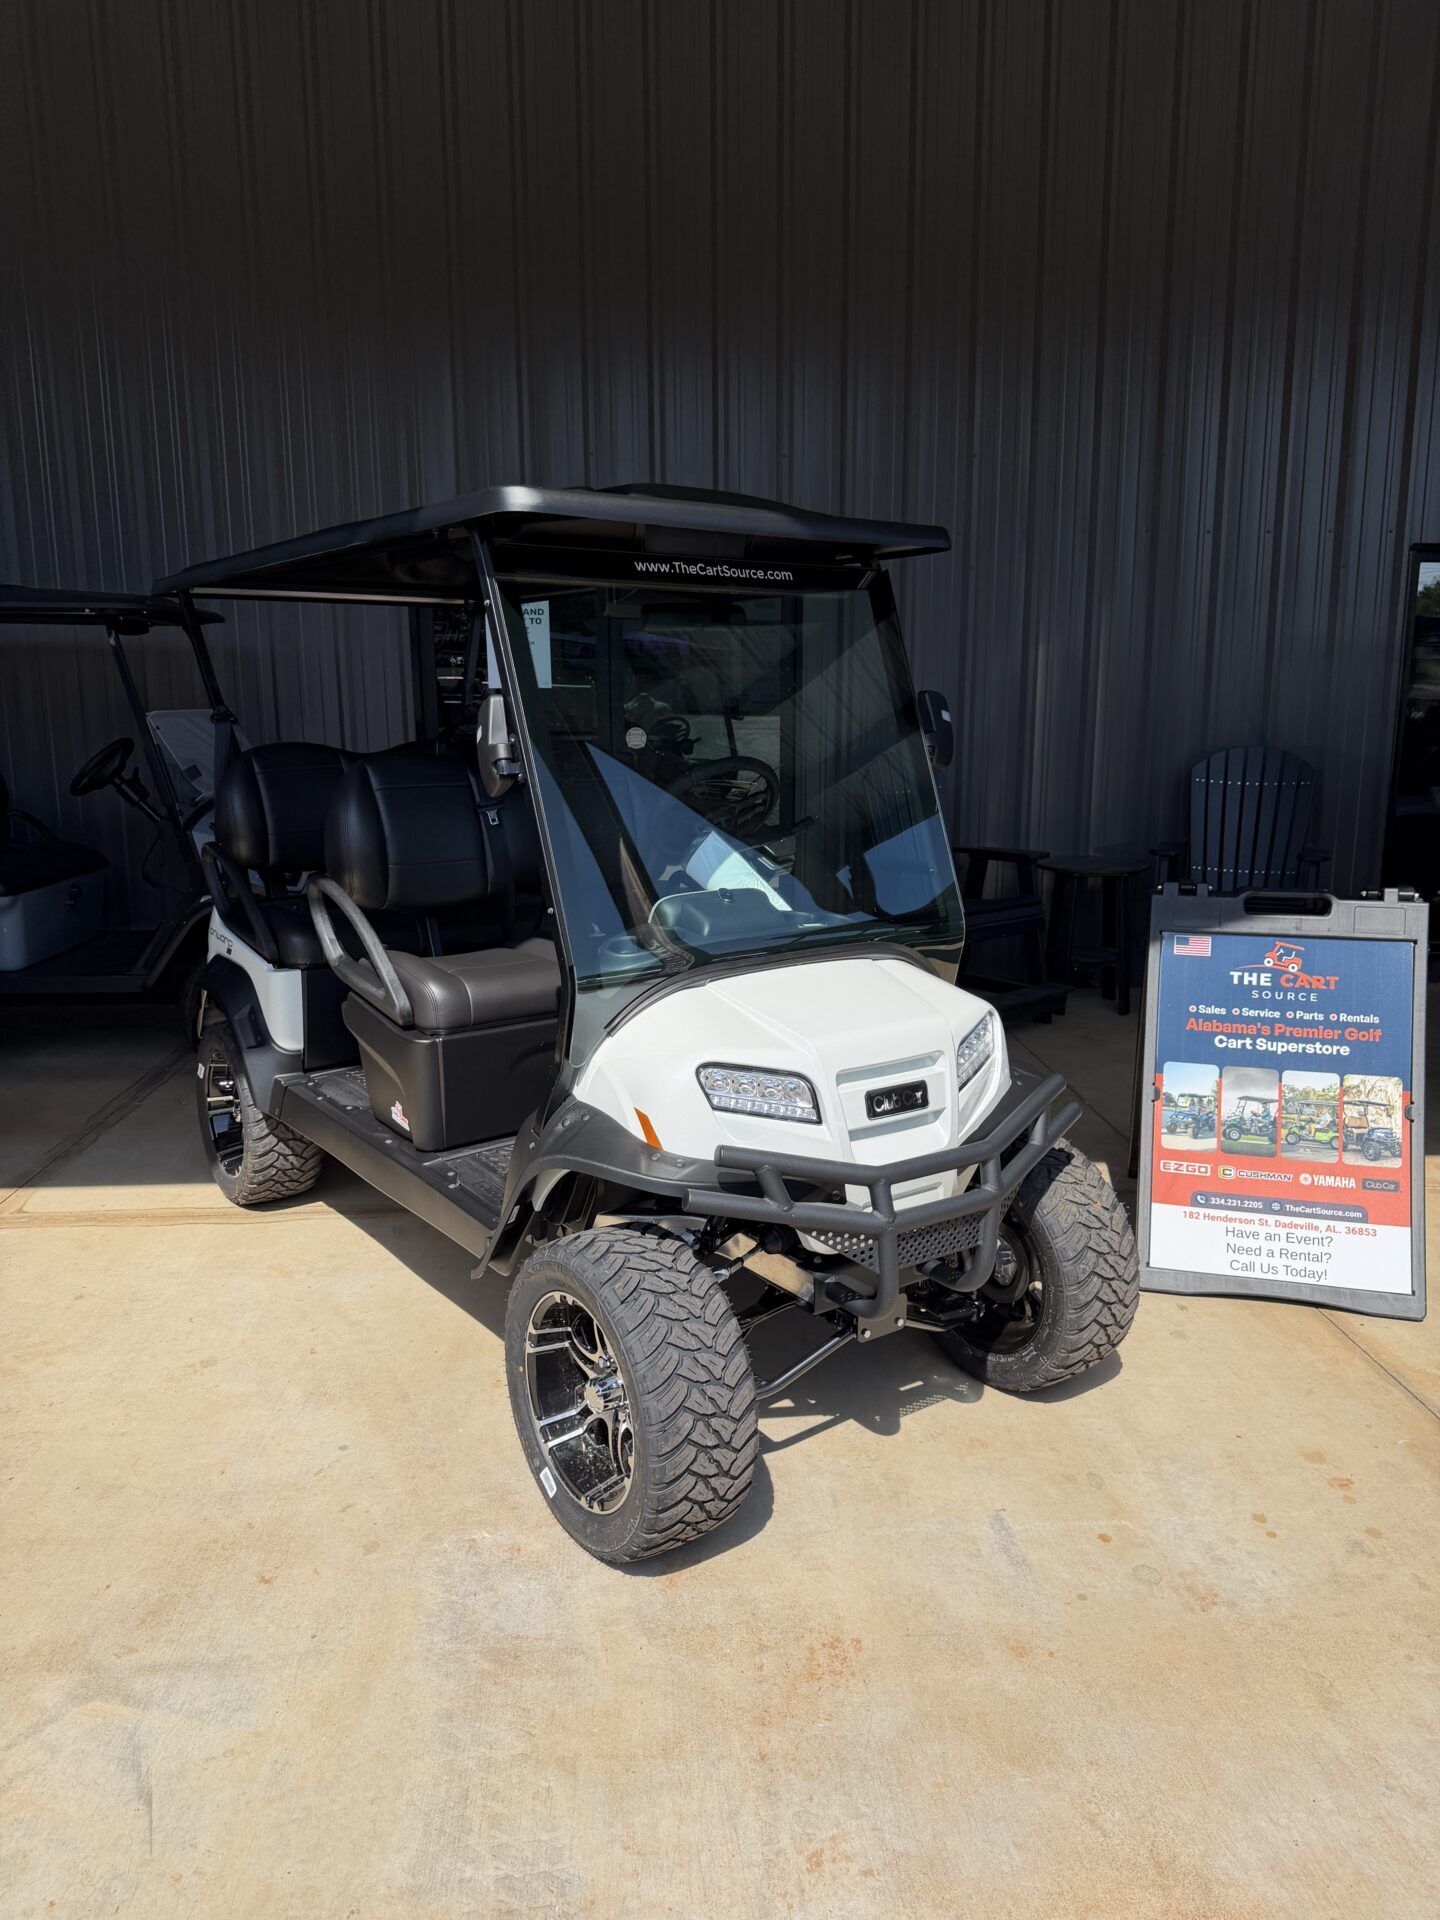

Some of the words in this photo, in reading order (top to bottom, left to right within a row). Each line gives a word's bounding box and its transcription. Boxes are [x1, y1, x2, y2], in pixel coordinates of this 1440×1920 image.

[634, 561, 793, 581] www.TheCartSource.com
[1229, 971, 1272, 987] THE
[1279, 974, 1340, 990] CART
[1251, 990, 1318, 1002] SOURCE
[1198, 1005, 1226, 1015] Sales
[1241, 1008, 1281, 1019] Service
[1296, 1011, 1324, 1021] Parts
[1339, 1013, 1380, 1024] Rentals
[1185, 1018, 1271, 1036] Alabama's
[1274, 1024, 1341, 1040] Premier
[1344, 1027, 1382, 1042] Golf
[1214, 1035, 1252, 1050] Cart
[1255, 1038, 1351, 1056] Superstore
[1238, 1170, 1292, 1181] CUSHMAN
[1313, 1174, 1356, 1189] YAMAHA
[1209, 1196, 1263, 1209] 334.231.2205
[1285, 1204, 1363, 1219] TheCartSource.com
[1183, 1210, 1200, 1220] 182
[1203, 1212, 1256, 1226] Henderson
[1258, 1218, 1271, 1227] St.
[1274, 1219, 1323, 1234] Dadeville,
[1325, 1224, 1342, 1234] AL.
[1344, 1226, 1377, 1237] 36853
[1225, 1226, 1260, 1240] Have
[1264, 1231, 1281, 1242] an
[1286, 1232, 1333, 1247] Event?
[1226, 1243, 1262, 1257] Need
[1266, 1249, 1275, 1258] a
[1279, 1248, 1332, 1264] Rental?
[1229, 1259, 1256, 1273] Call
[1260, 1263, 1279, 1275] Us
[1282, 1264, 1328, 1282] Today!
